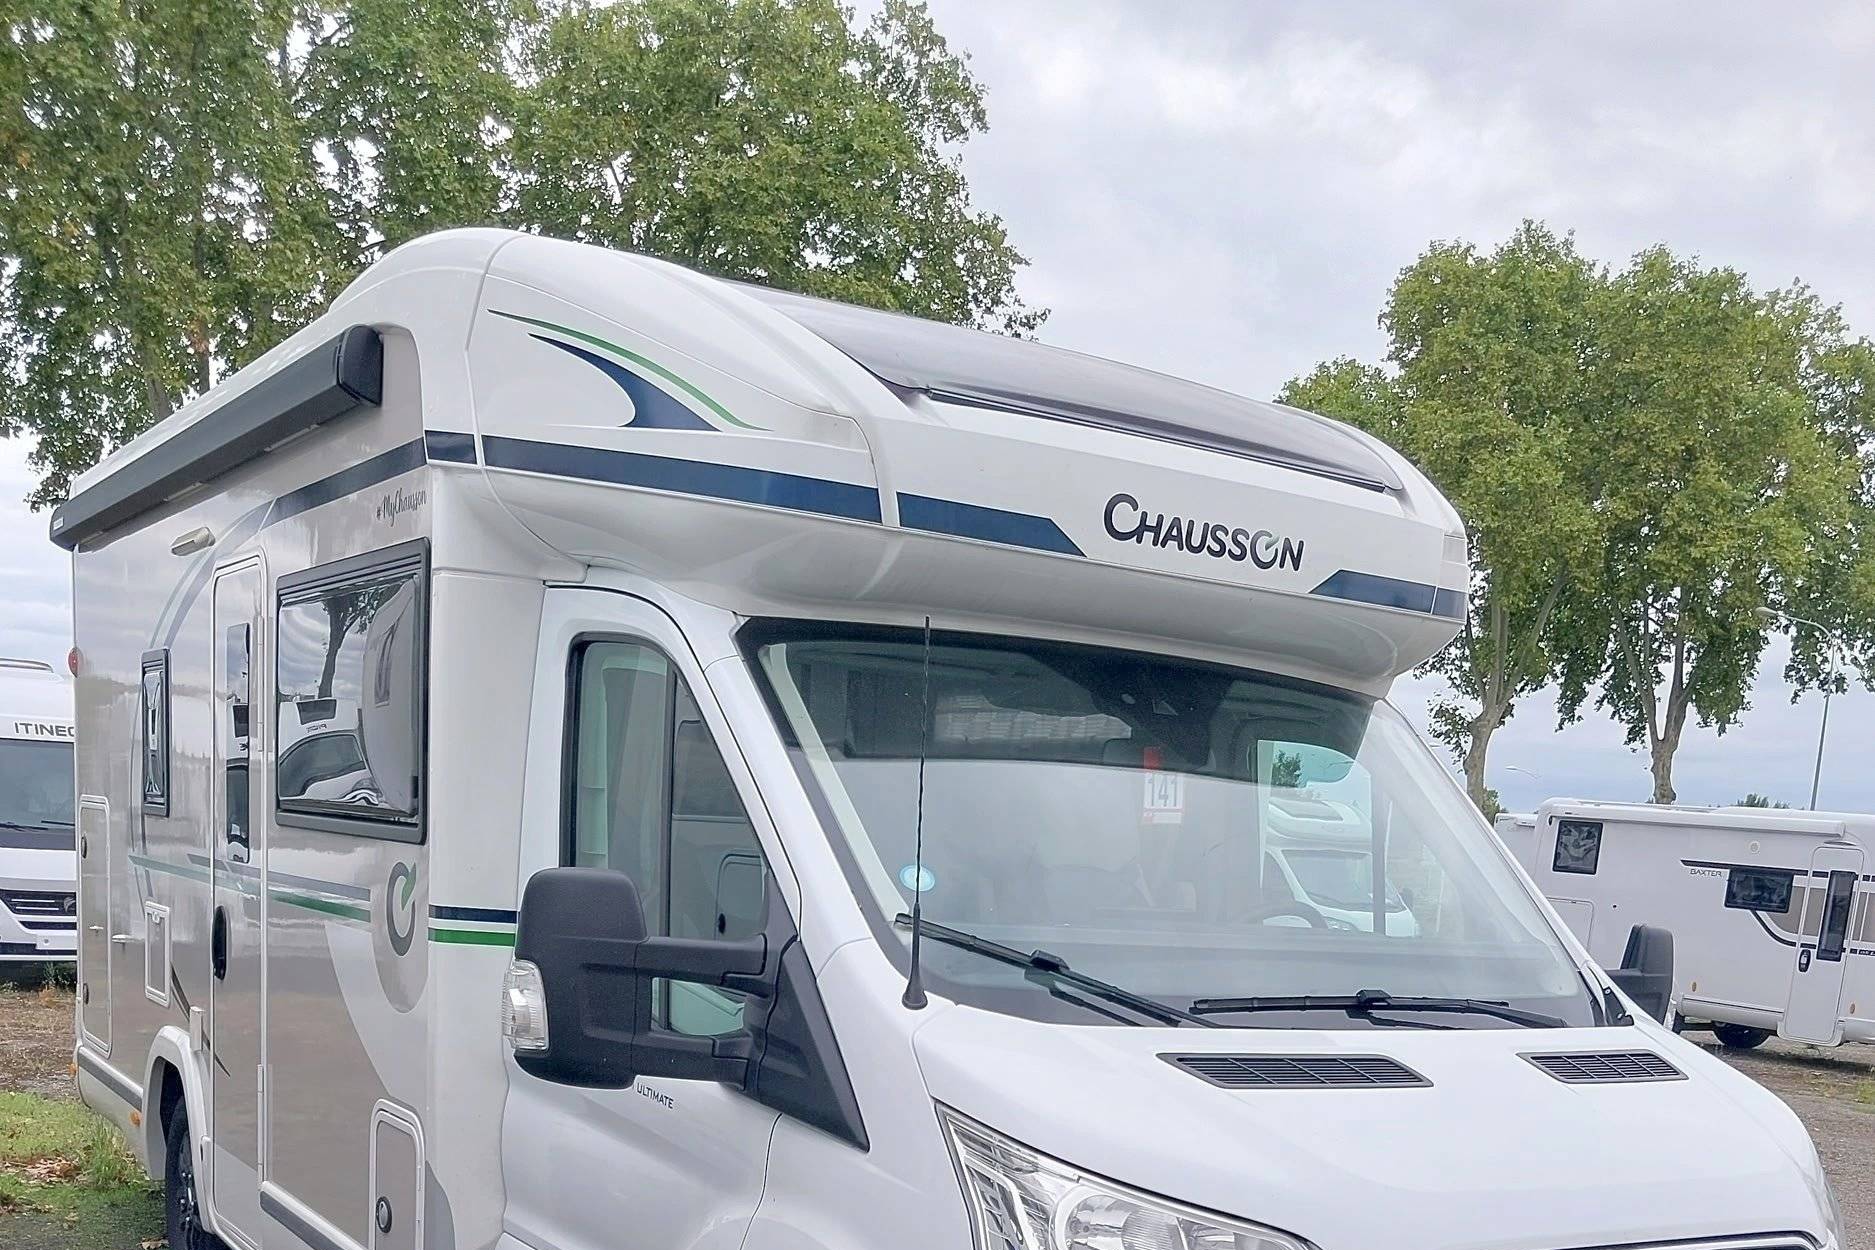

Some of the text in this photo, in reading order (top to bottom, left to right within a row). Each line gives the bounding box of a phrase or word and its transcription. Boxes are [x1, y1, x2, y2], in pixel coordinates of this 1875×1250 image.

[1147, 775, 1177, 807] 141
[1690, 868, 1722, 877] BAXTER
[636, 1082, 675, 1110] ULTIMATE
